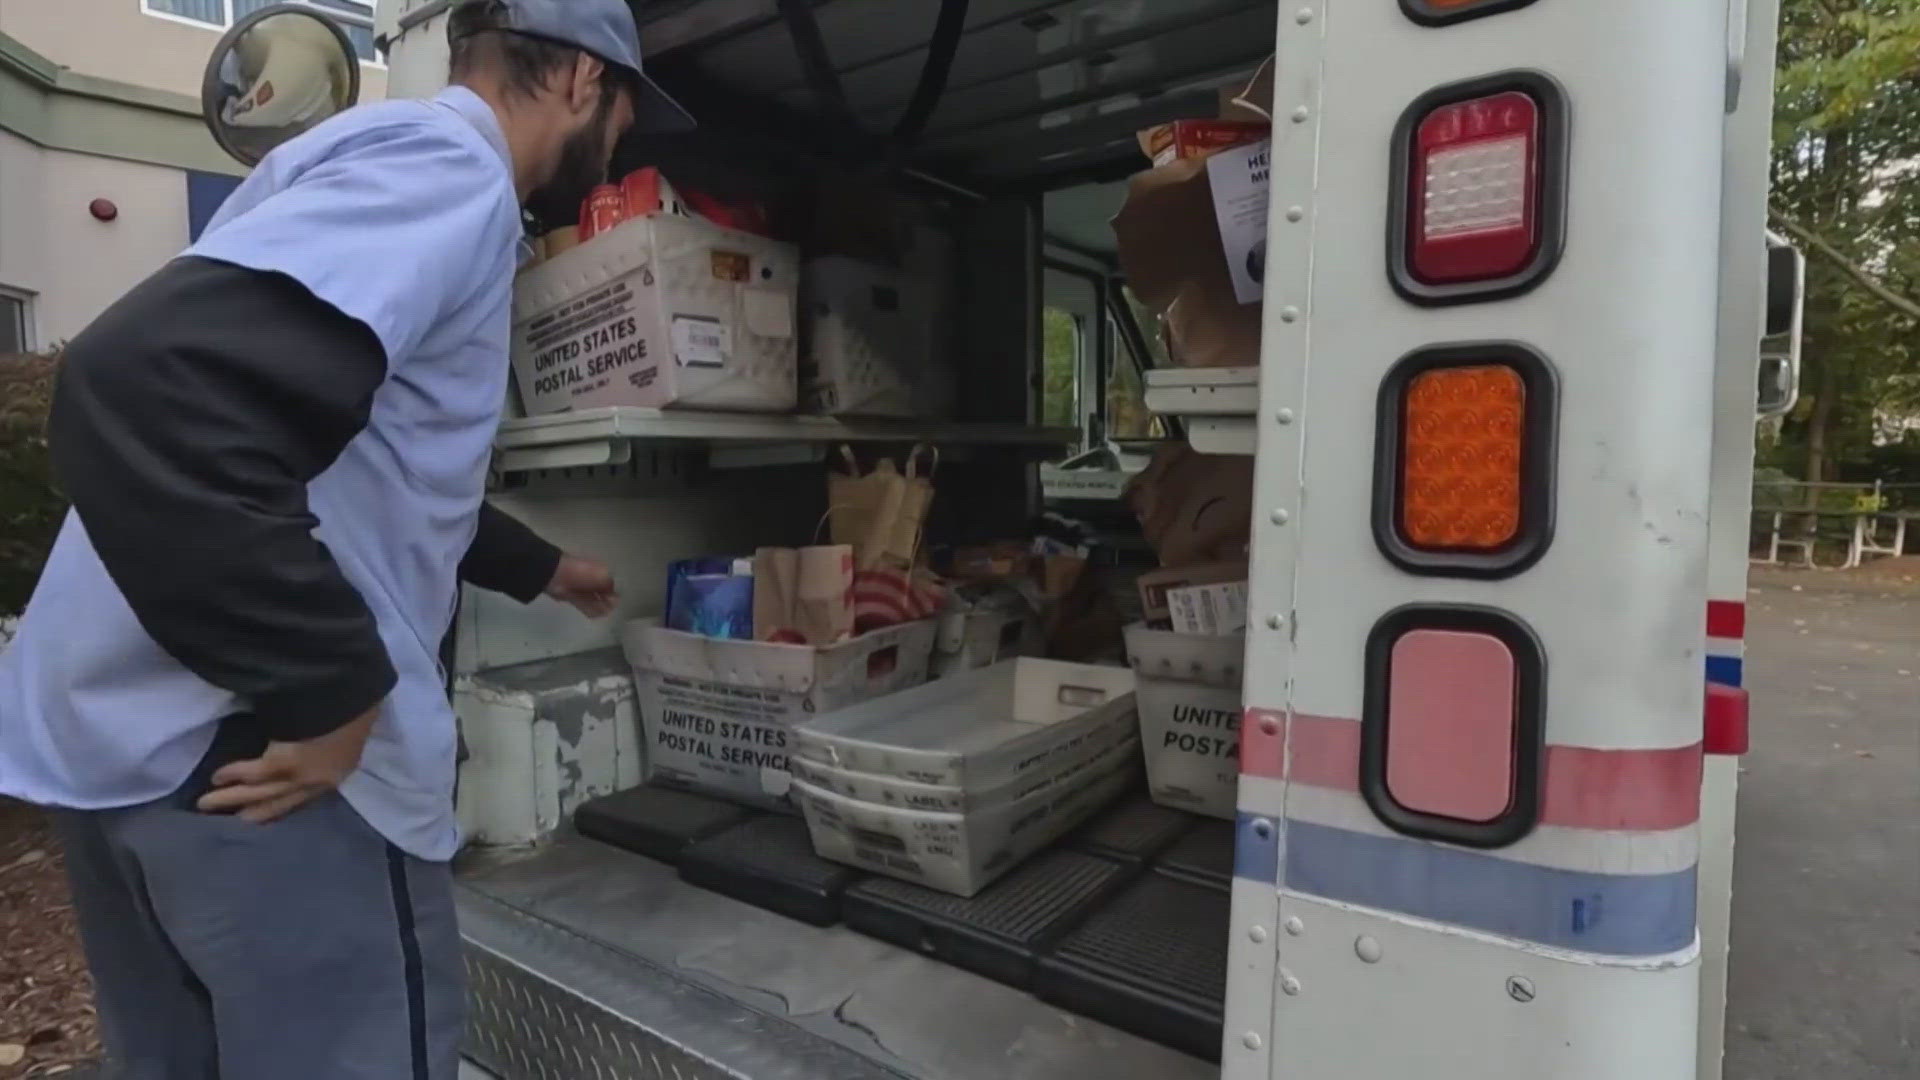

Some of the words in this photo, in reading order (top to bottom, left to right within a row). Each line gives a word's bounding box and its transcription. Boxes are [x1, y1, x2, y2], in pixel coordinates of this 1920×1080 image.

[535, 340, 580, 372] UNITED
[583, 317, 637, 353] STATES
[535, 365, 584, 397] POSTAL
[586, 339, 648, 377] SERVICE
[658, 730, 716, 759] POSTAL
[662, 709, 716, 735] UNITED
[720, 721, 787, 748] STATES
